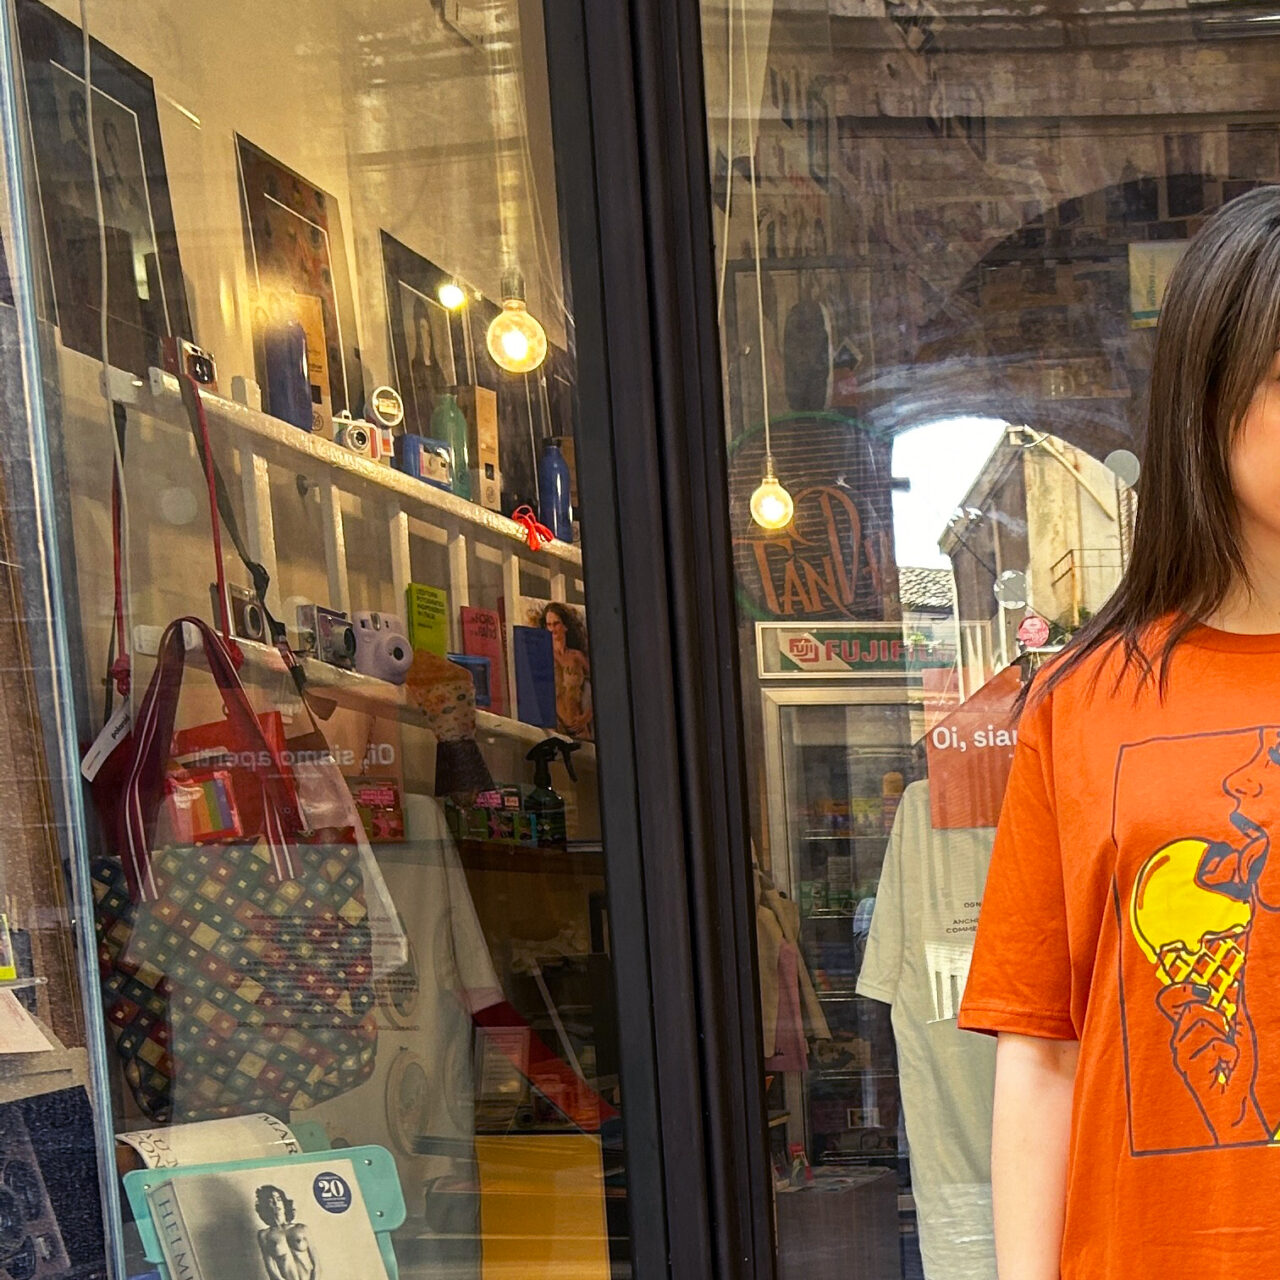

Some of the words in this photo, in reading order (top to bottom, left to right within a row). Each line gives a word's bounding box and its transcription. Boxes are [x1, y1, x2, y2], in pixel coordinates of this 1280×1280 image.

[932, 726, 967, 752] Oi,
[946, 926, 977, 934] COMME
[318, 1180, 344, 1198] 20
